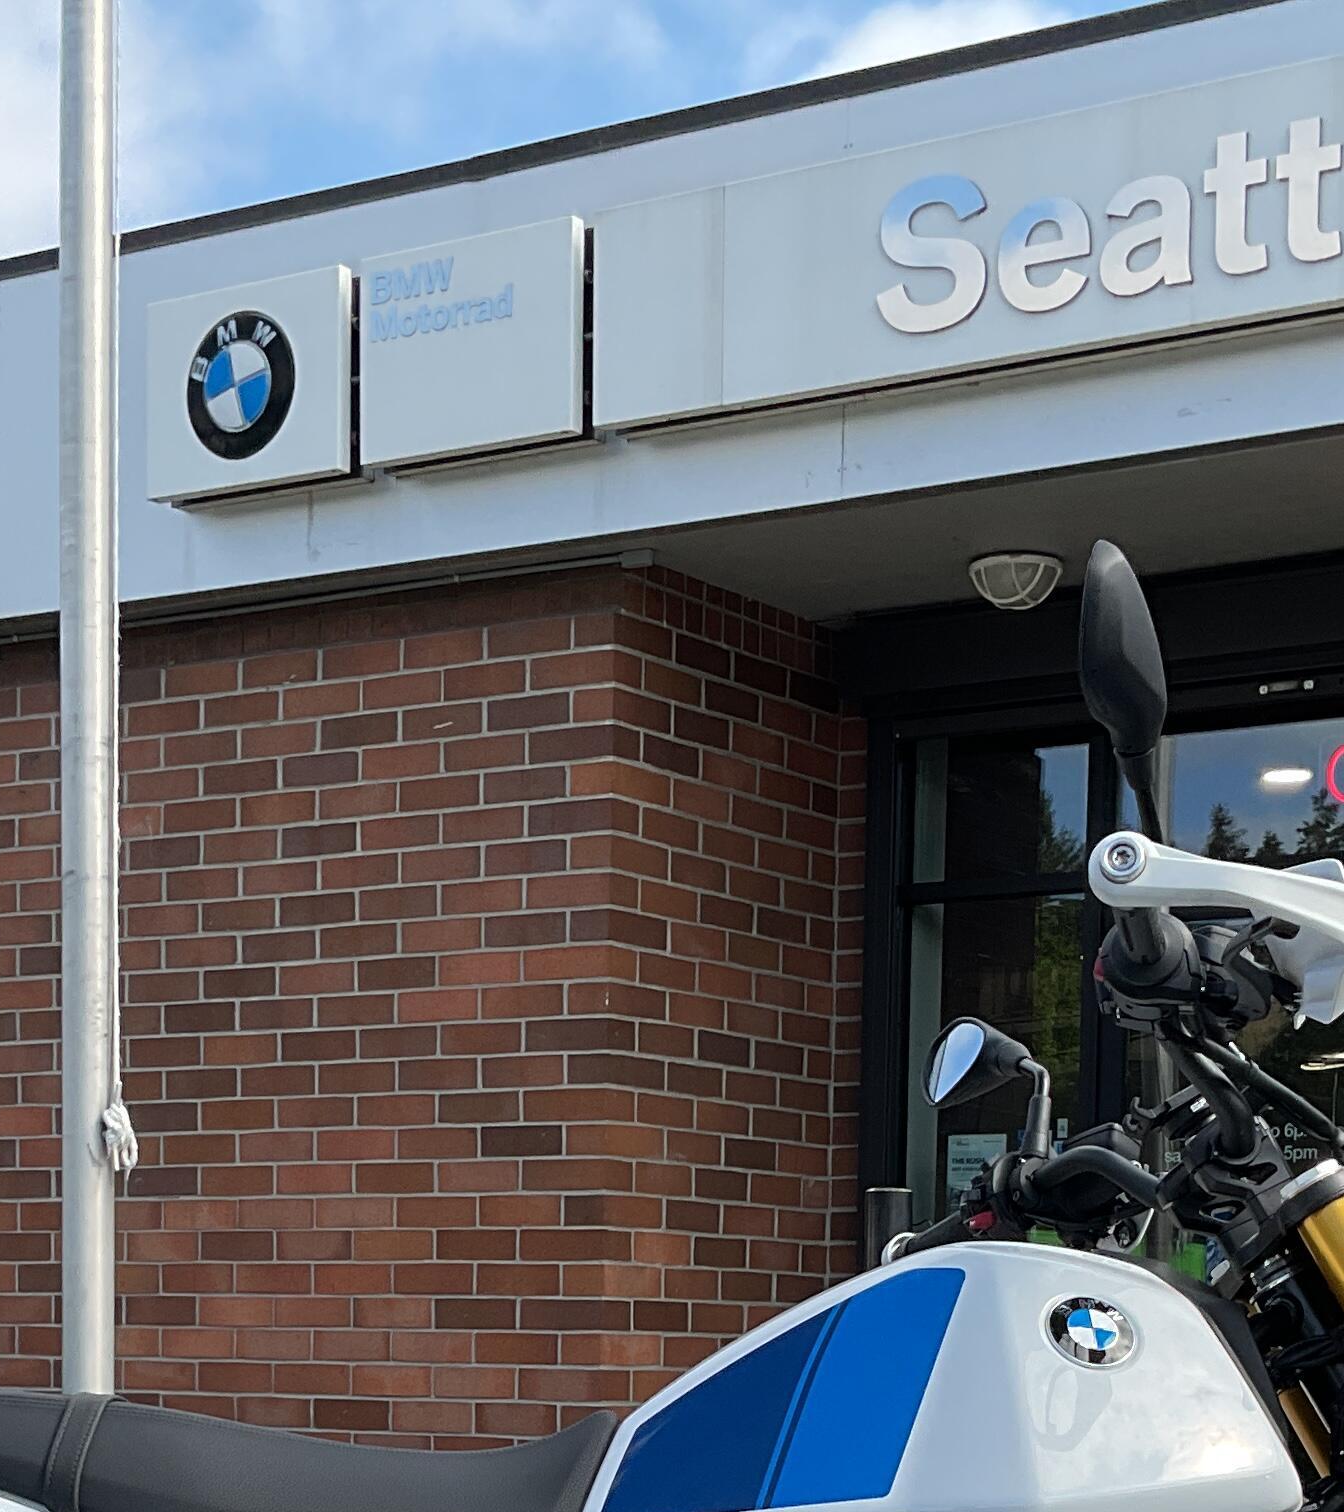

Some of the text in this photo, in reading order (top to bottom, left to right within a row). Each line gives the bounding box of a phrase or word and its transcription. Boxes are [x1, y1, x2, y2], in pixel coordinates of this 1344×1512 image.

[369, 255, 455, 306] BMW
[369, 283, 514, 344] Motorrad
[188, 318, 276, 382] BMW
[1283, 1147, 1319, 1164] 5pm
